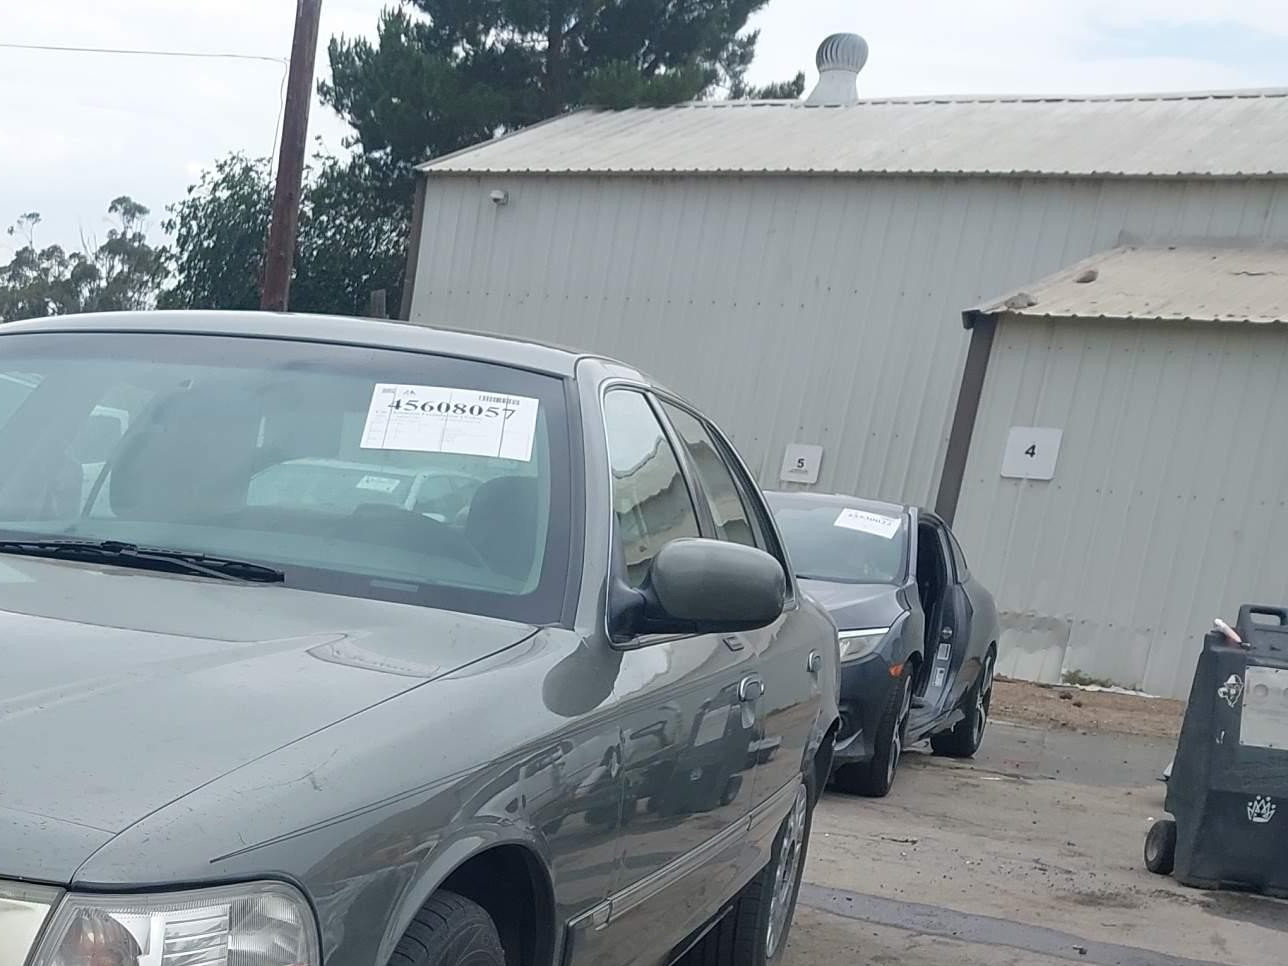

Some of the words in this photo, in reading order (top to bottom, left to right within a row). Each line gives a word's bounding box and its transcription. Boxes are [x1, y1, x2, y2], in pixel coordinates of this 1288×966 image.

[388, 398, 516, 420] 45608057
[1024, 444, 1036, 458] 4
[797, 458, 805, 469] 5
